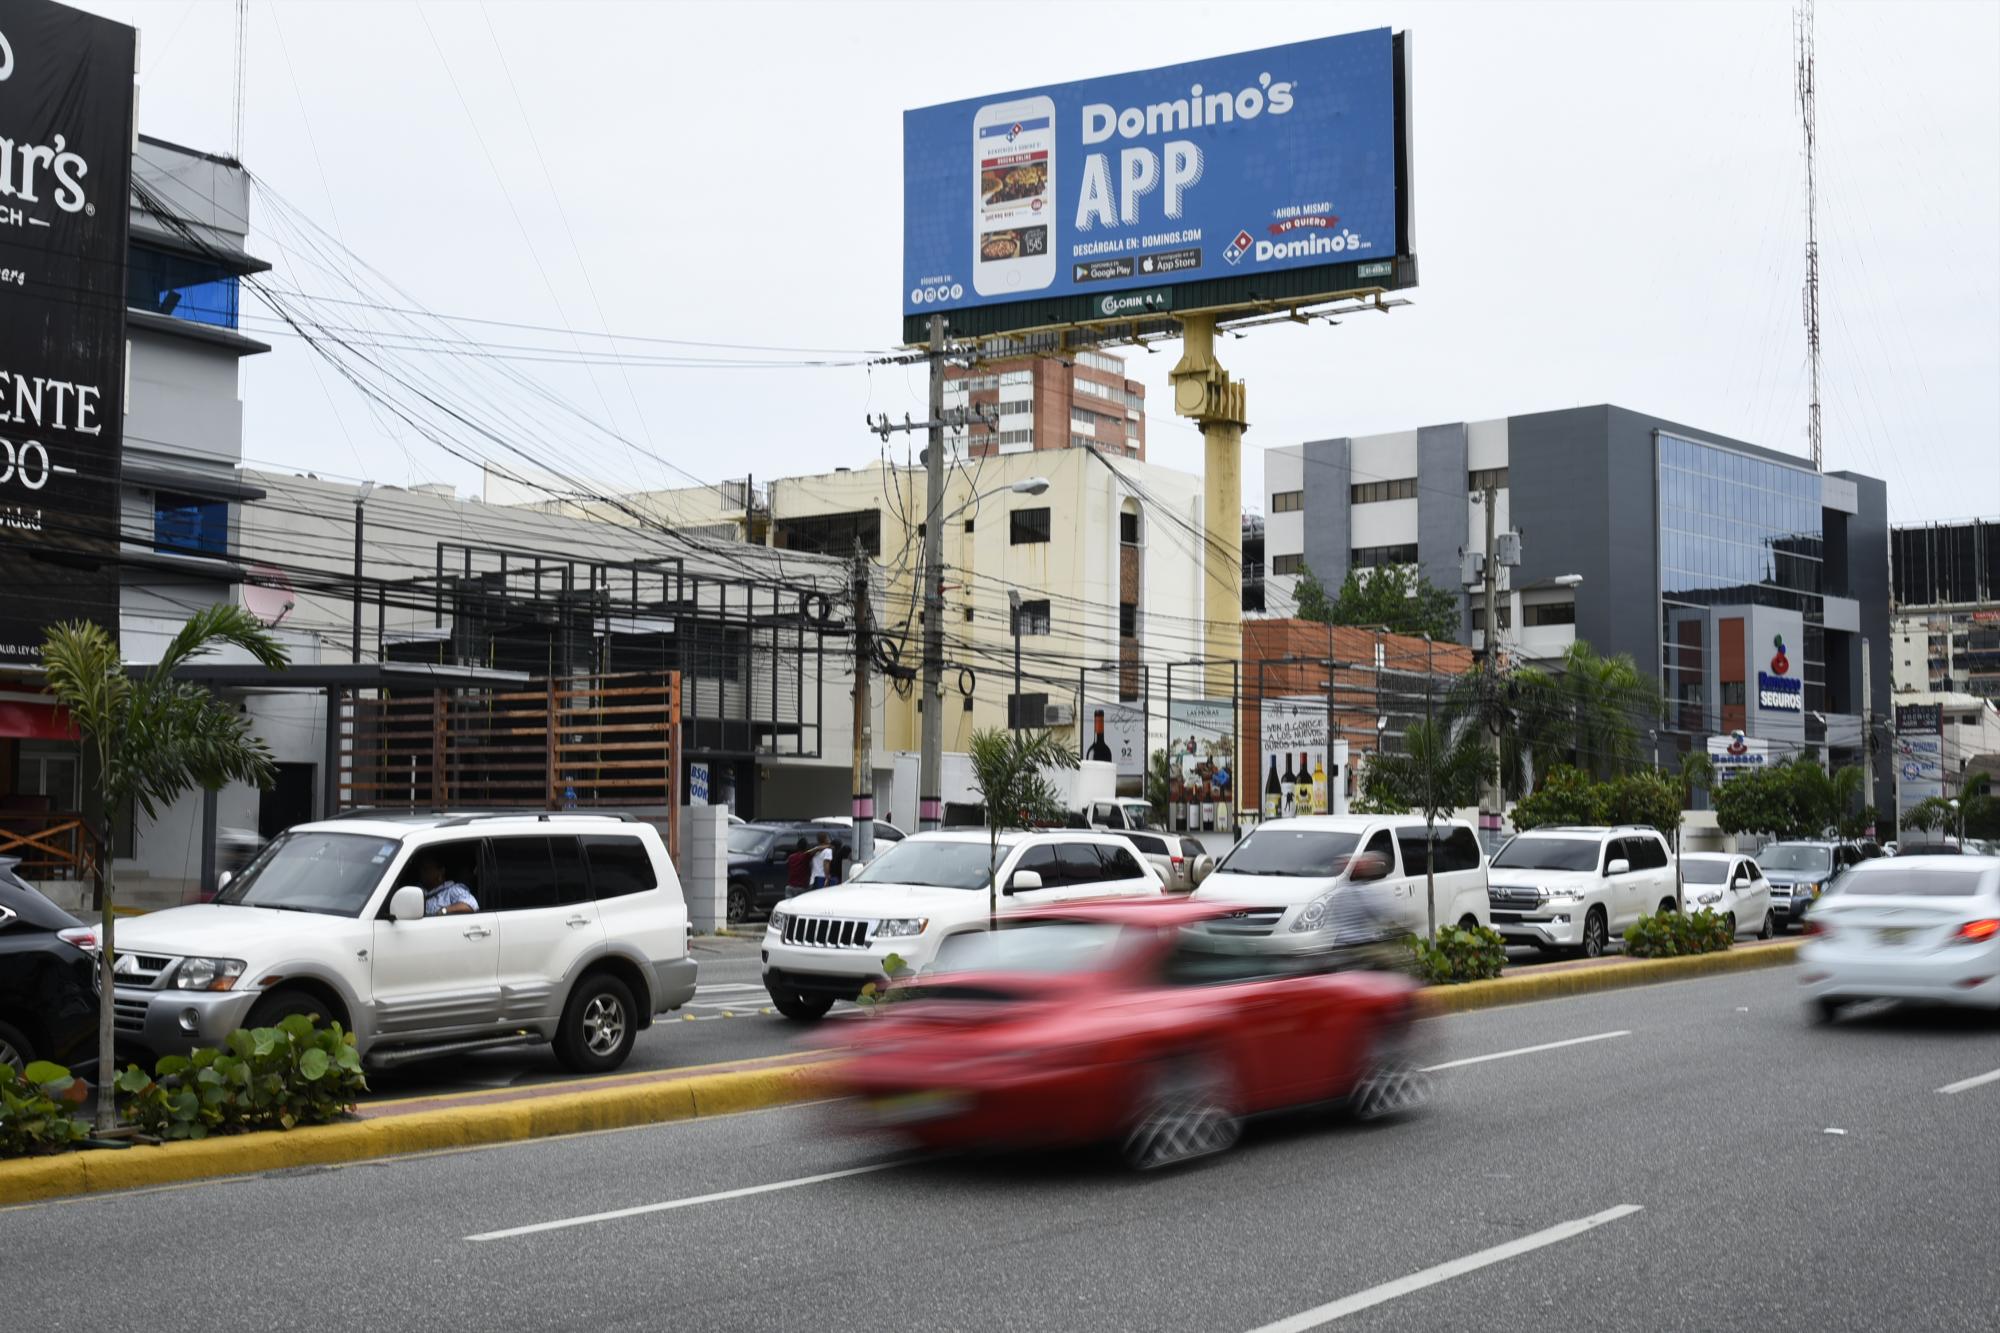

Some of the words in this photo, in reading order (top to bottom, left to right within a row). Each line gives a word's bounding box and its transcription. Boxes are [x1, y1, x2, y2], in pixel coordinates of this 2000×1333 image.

[1082, 72, 1294, 145] Domino's
[1075, 139, 1205, 232] APP
[1276, 206, 1301, 219] AHORA
[1303, 201, 1330, 214] MISMO
[1280, 220, 1291, 232] YO
[1294, 217, 1327, 227] QUIERO
[1073, 239, 1124, 257] DESCÁRGALA
[1126, 237, 1139, 250] EN:
[1142, 228, 1201, 248] DOMINOS.COM
[1090, 267, 1115, 278] Google
[1116, 265, 1131, 275] Play
[1157, 261, 1174, 274] App
[1174, 258, 1196, 270] Store
[1760, 690, 1801, 710] SEGUROS
[1121, 747, 1133, 758] 92
[1711, 753, 1764, 764] Banesco
